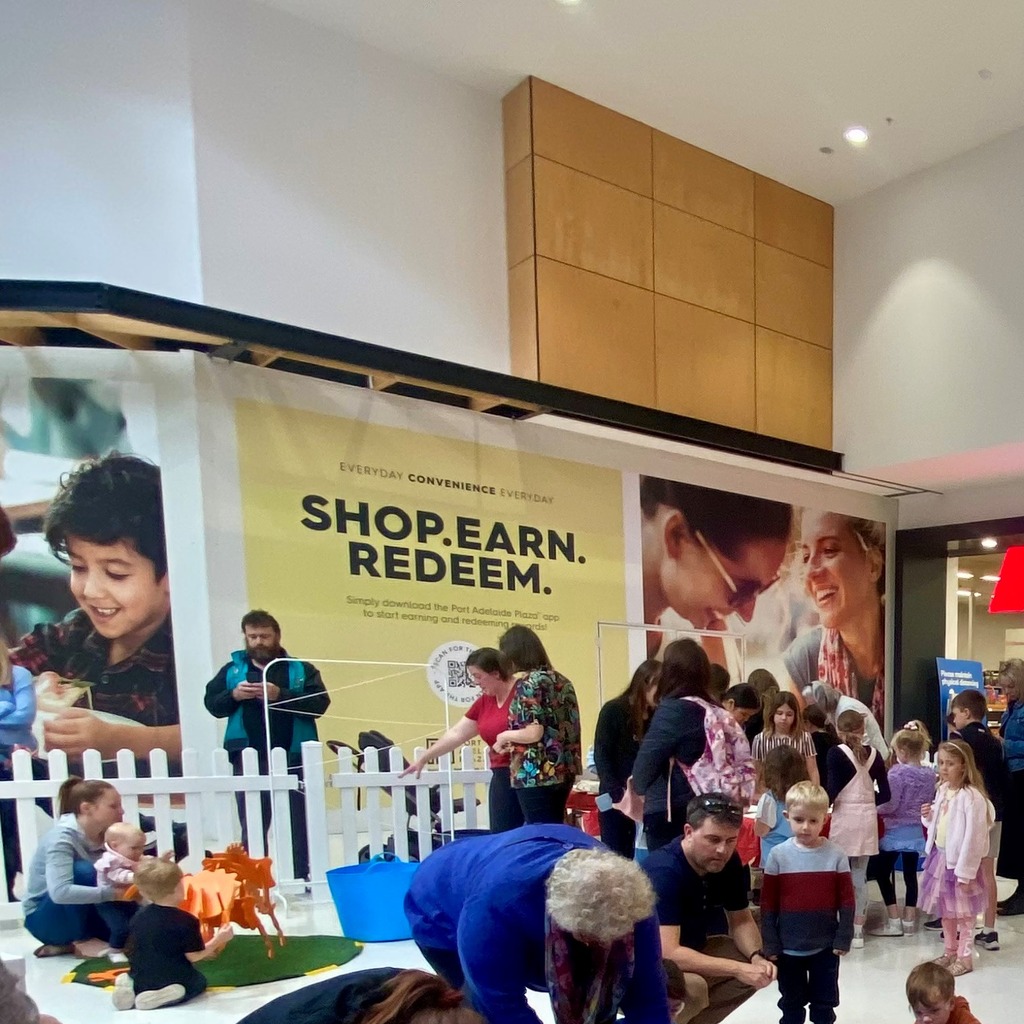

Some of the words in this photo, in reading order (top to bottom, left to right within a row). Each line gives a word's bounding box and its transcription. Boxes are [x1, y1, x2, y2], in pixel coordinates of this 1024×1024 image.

[339, 461, 404, 481] EVERYDAY
[408, 473, 496, 495] CONVENIENCE
[500, 487, 555, 505] EVERYDAY
[348, 541, 552, 595] REDEEM.
[346, 595, 380, 607] Simply
[382, 598, 431, 610] download
[434, 603, 448, 612] the
[451, 604, 470, 614] Port
[472, 606, 512, 617] Adelaide
[542, 614, 560, 623] app
[363, 609, 374, 618] to
[376, 610, 399, 619] start
[401, 613, 439, 624] earning
[441, 615, 460, 624] and
[462, 617, 510, 629] redeeming
